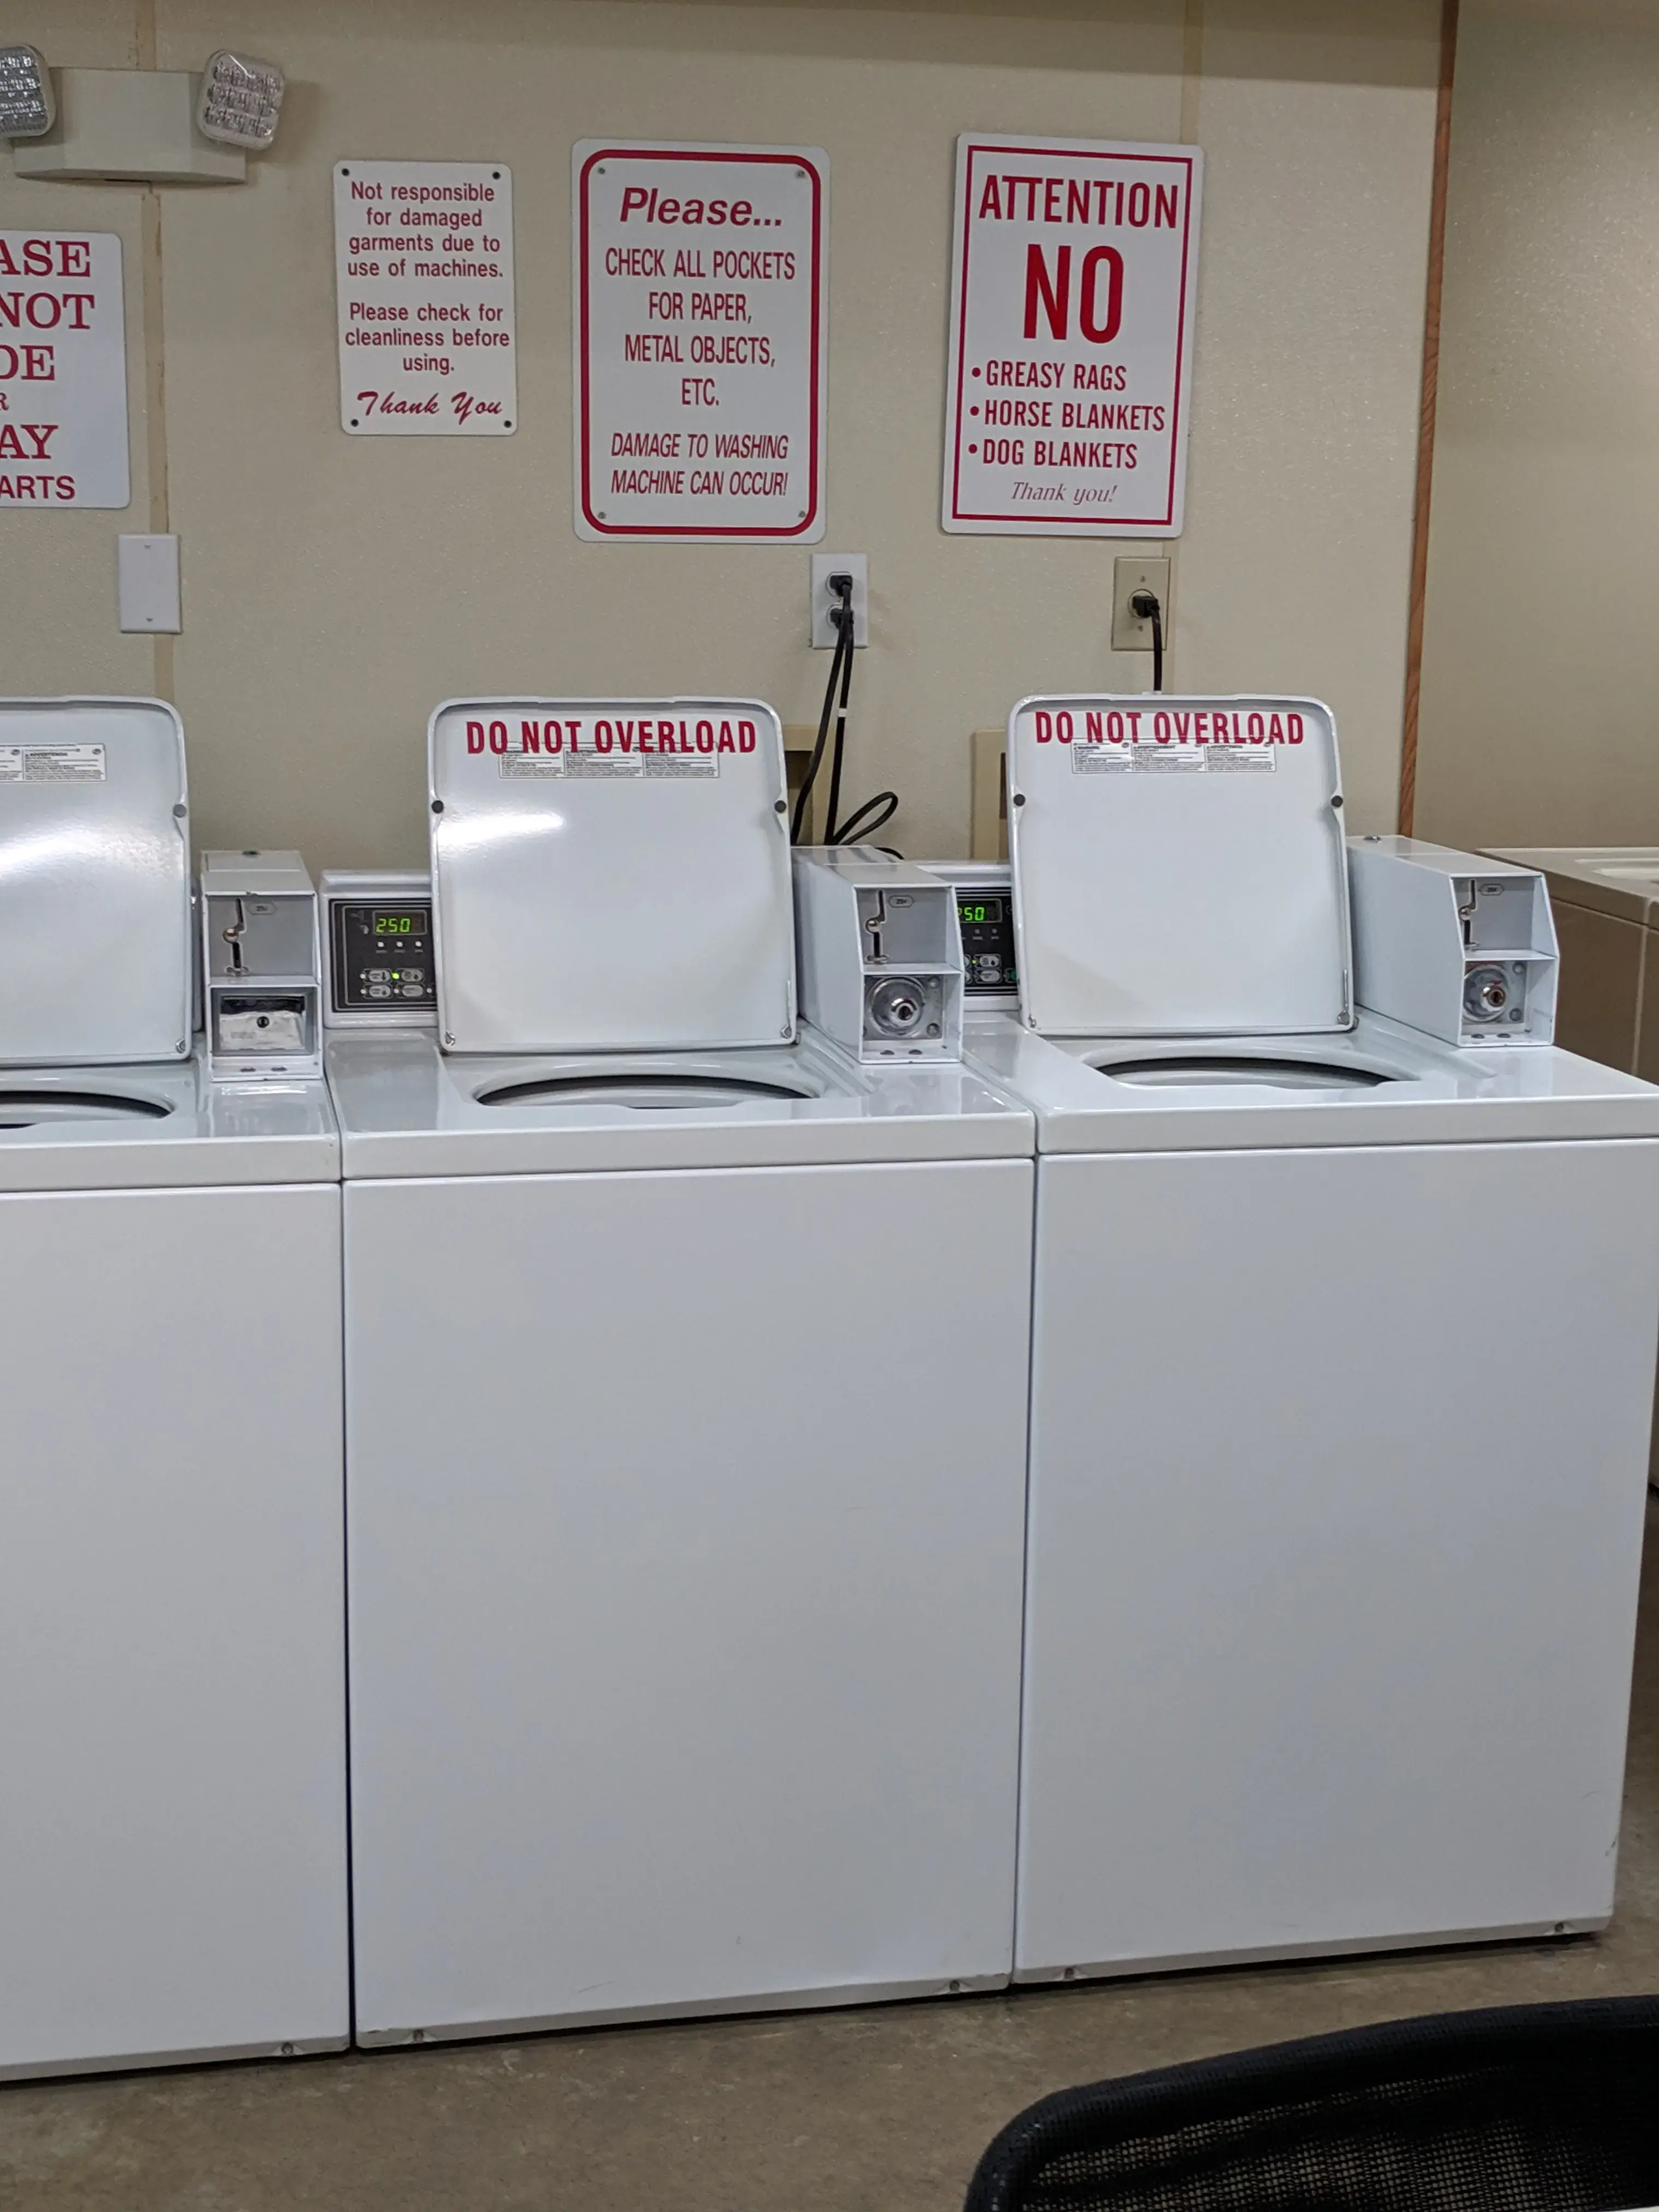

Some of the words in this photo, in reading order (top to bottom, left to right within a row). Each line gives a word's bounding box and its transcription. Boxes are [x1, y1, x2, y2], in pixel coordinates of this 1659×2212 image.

[351, 181, 383, 200] Not
[391, 183, 495, 204] responsible
[620, 186, 782, 227] Please...
[979, 174, 1179, 228] ATTENTION
[366, 207, 391, 225] for
[399, 208, 483, 230] damaged
[349, 234, 434, 255] garments
[442, 234, 474, 252] due
[483, 235, 501, 252] to
[348, 262, 380, 276] use
[389, 258, 406, 276] of
[415, 258, 503, 278] machines.
[605, 247, 666, 276] CHECK
[674, 251, 706, 278] ALL
[713, 250, 795, 279] POCKETS
[649, 291, 683, 319] FOR
[691, 293, 752, 324] PAPER,
[1023, 243, 1125, 344] NO
[0, 292, 95, 329] NOT
[350, 302, 409, 321] Please
[417, 303, 470, 321] check
[479, 303, 503, 321] for
[345, 328, 444, 346] cleanliness
[452, 328, 510, 346] before
[625, 334, 683, 362] METAL
[691, 336, 775, 368] OBJECTS,
[403, 353, 454, 375] using.
[985, 360, 1064, 389] GREASY
[1073, 363, 1127, 392] RAGS
[357, 391, 439, 416] Thank
[451, 391, 502, 425] You
[681, 378, 719, 406] ETC.
[984, 399, 1053, 427] HORSE
[1061, 402, 1165, 432] BLANKETS
[0, 424, 58, 460] AY
[611, 433, 681, 457] DAMAGE
[689, 434, 708, 458] TO
[715, 434, 788, 458] WASHING
[983, 438, 1024, 465] DOG
[1034, 440, 1137, 470] BLANKETS
[0, 475, 75, 499] ARTS
[611, 469, 685, 494] MACHINE
[690, 471, 723, 494] CAN
[729, 471, 787, 495] OCCUR!
[1011, 481, 1067, 501] Thank
[1072, 485, 1118, 505] you!
[466, 721, 508, 755] DO
[521, 720, 582, 755] NOT
[595, 720, 756, 754] OVERLOAD
[1034, 710, 1074, 744] DO
[1085, 711, 1142, 744] NOT
[1153, 711, 1304, 745] OVERLOAD
[376, 918, 410, 933] 250
